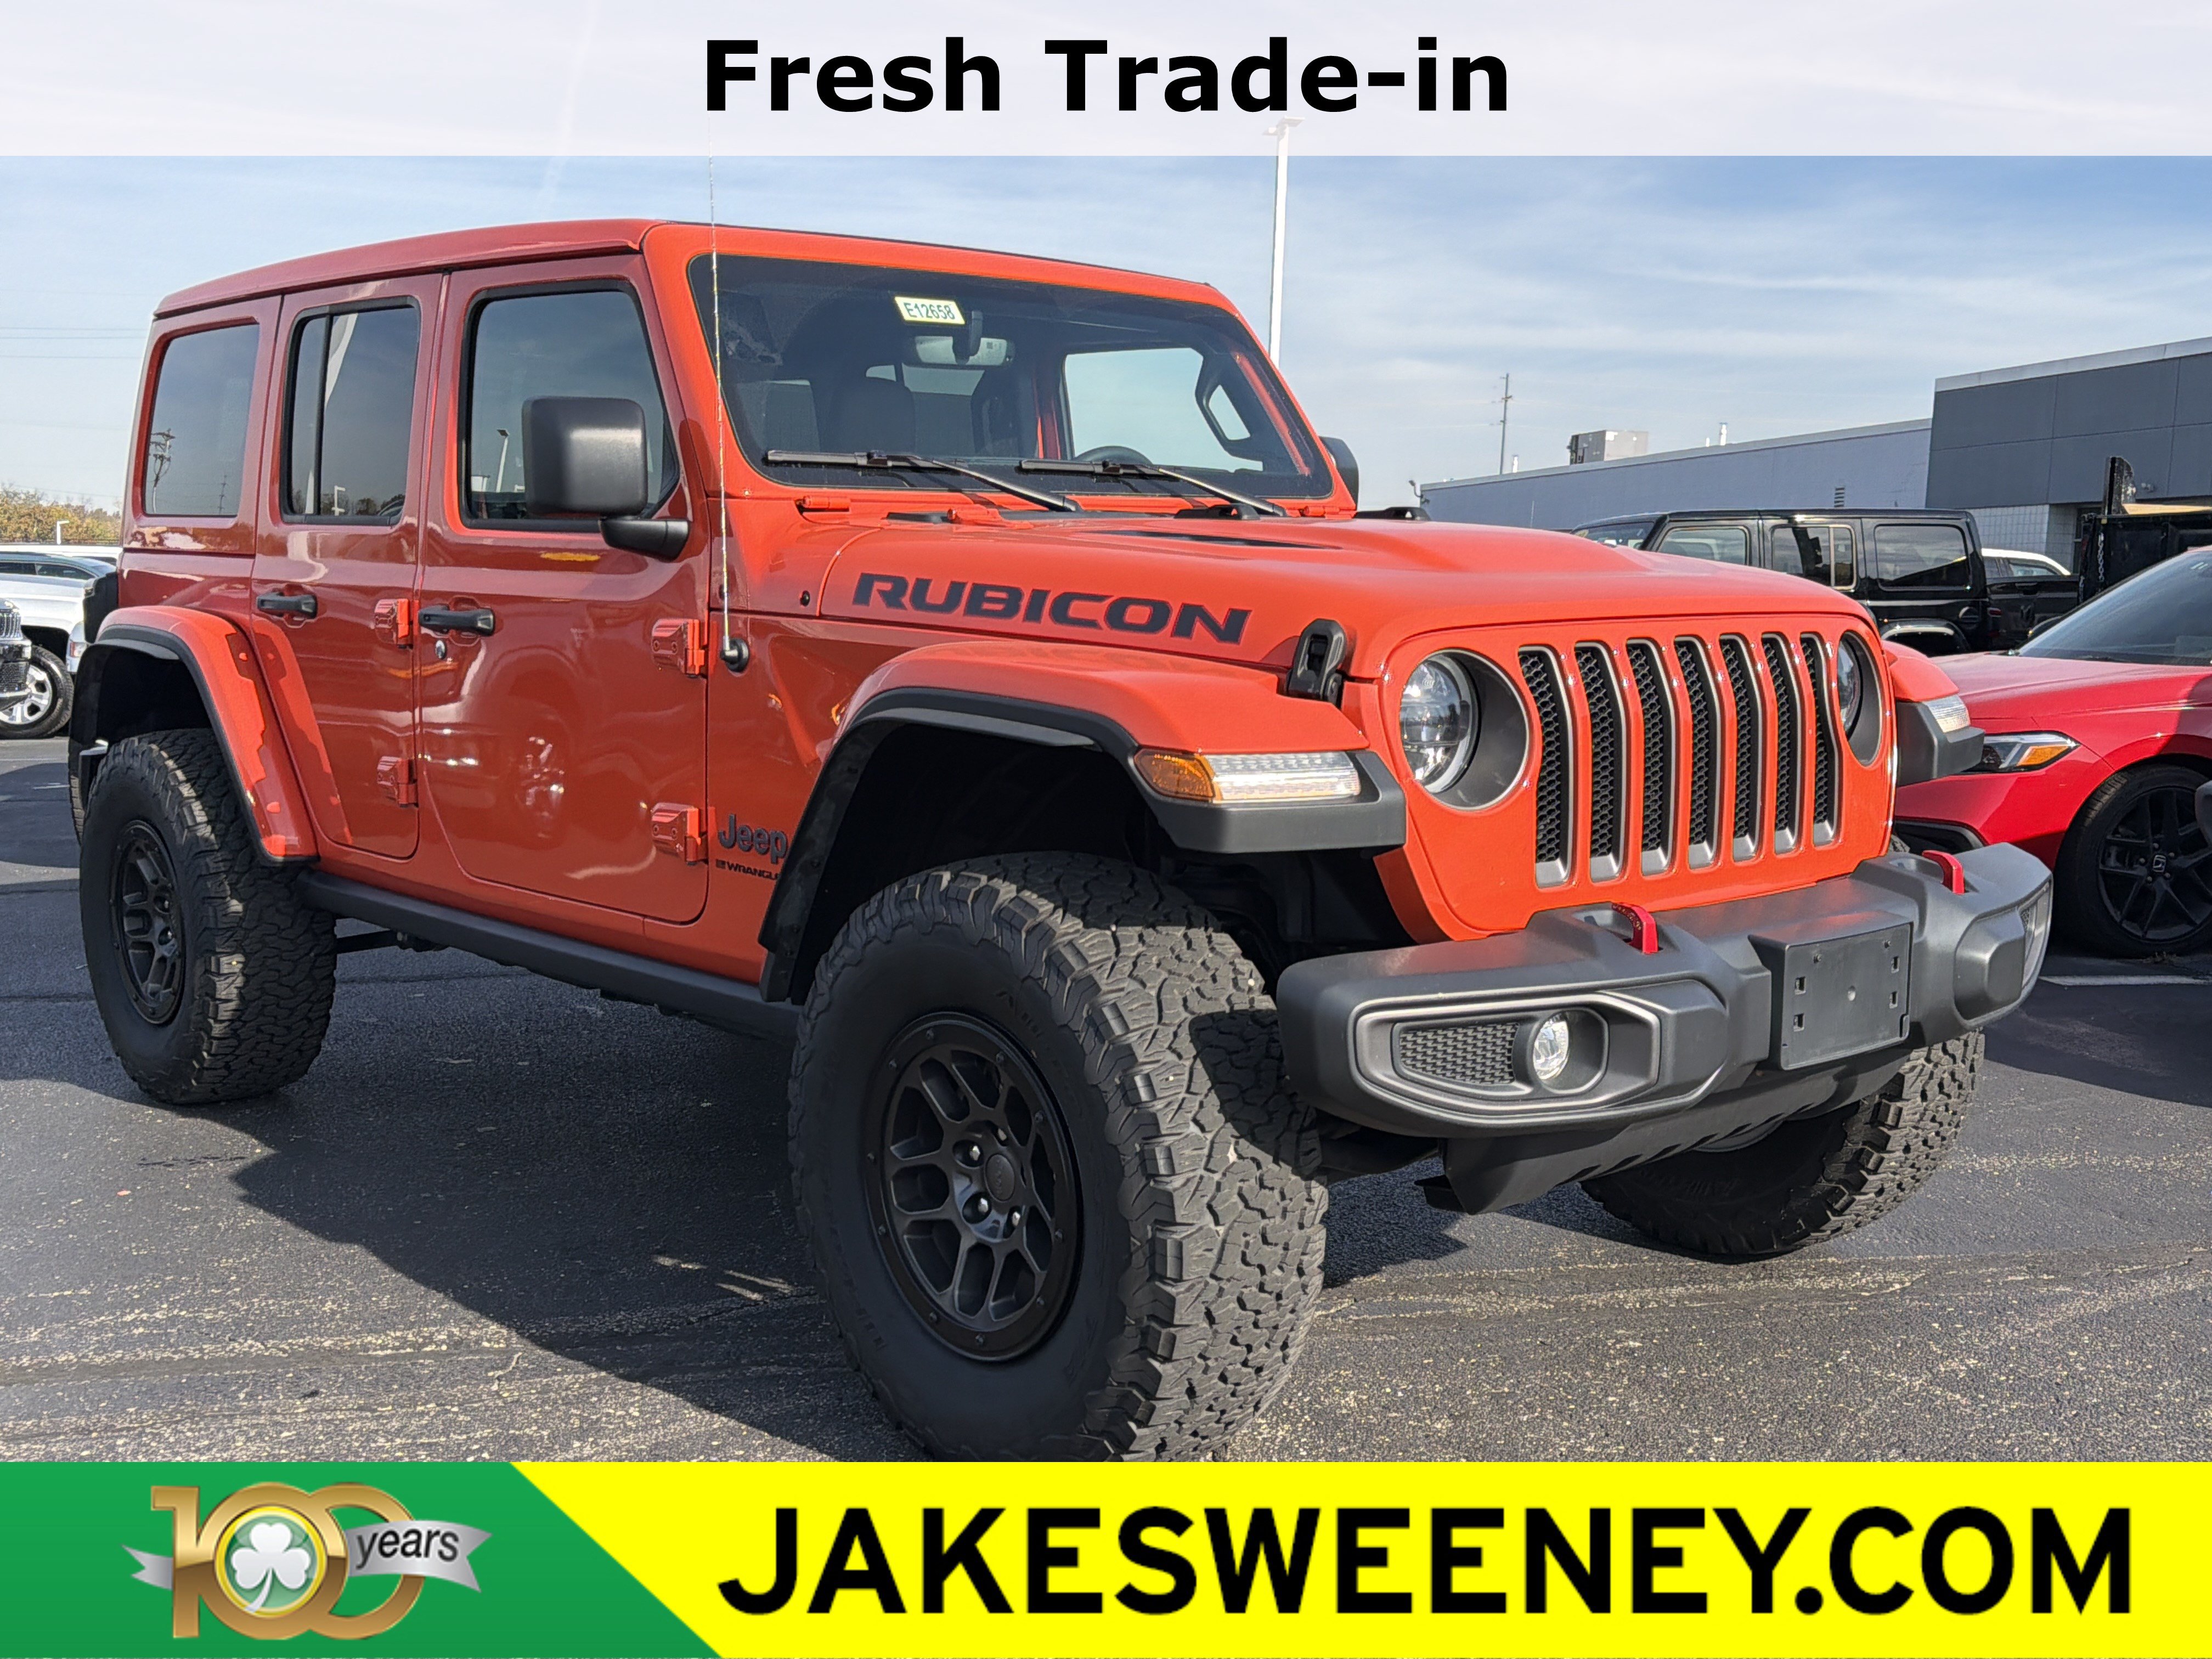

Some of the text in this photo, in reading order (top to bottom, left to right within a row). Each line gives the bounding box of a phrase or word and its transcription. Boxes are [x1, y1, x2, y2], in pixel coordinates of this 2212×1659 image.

[903, 302, 956, 320] E12658
[851, 572, 1253, 645] RUBICON
[718, 814, 788, 865] Jeep
